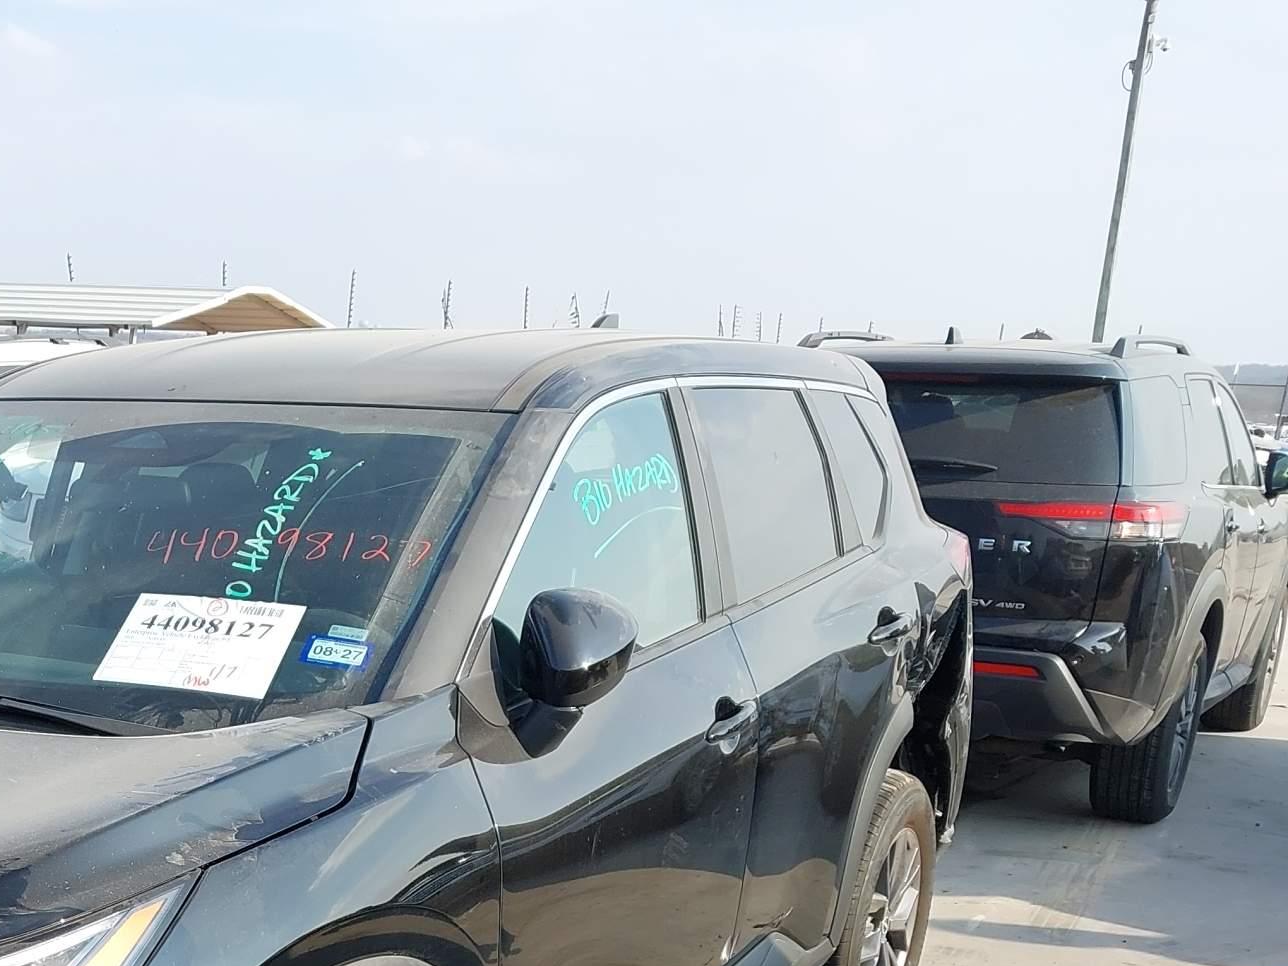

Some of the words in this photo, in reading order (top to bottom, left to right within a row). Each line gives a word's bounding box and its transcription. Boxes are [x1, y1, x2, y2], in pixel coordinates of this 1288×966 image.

[612, 453, 678, 502] HAZARD
[141, 614, 275, 640] 44098127
[313, 645, 333, 657] 08
[340, 649, 363, 661] 27
